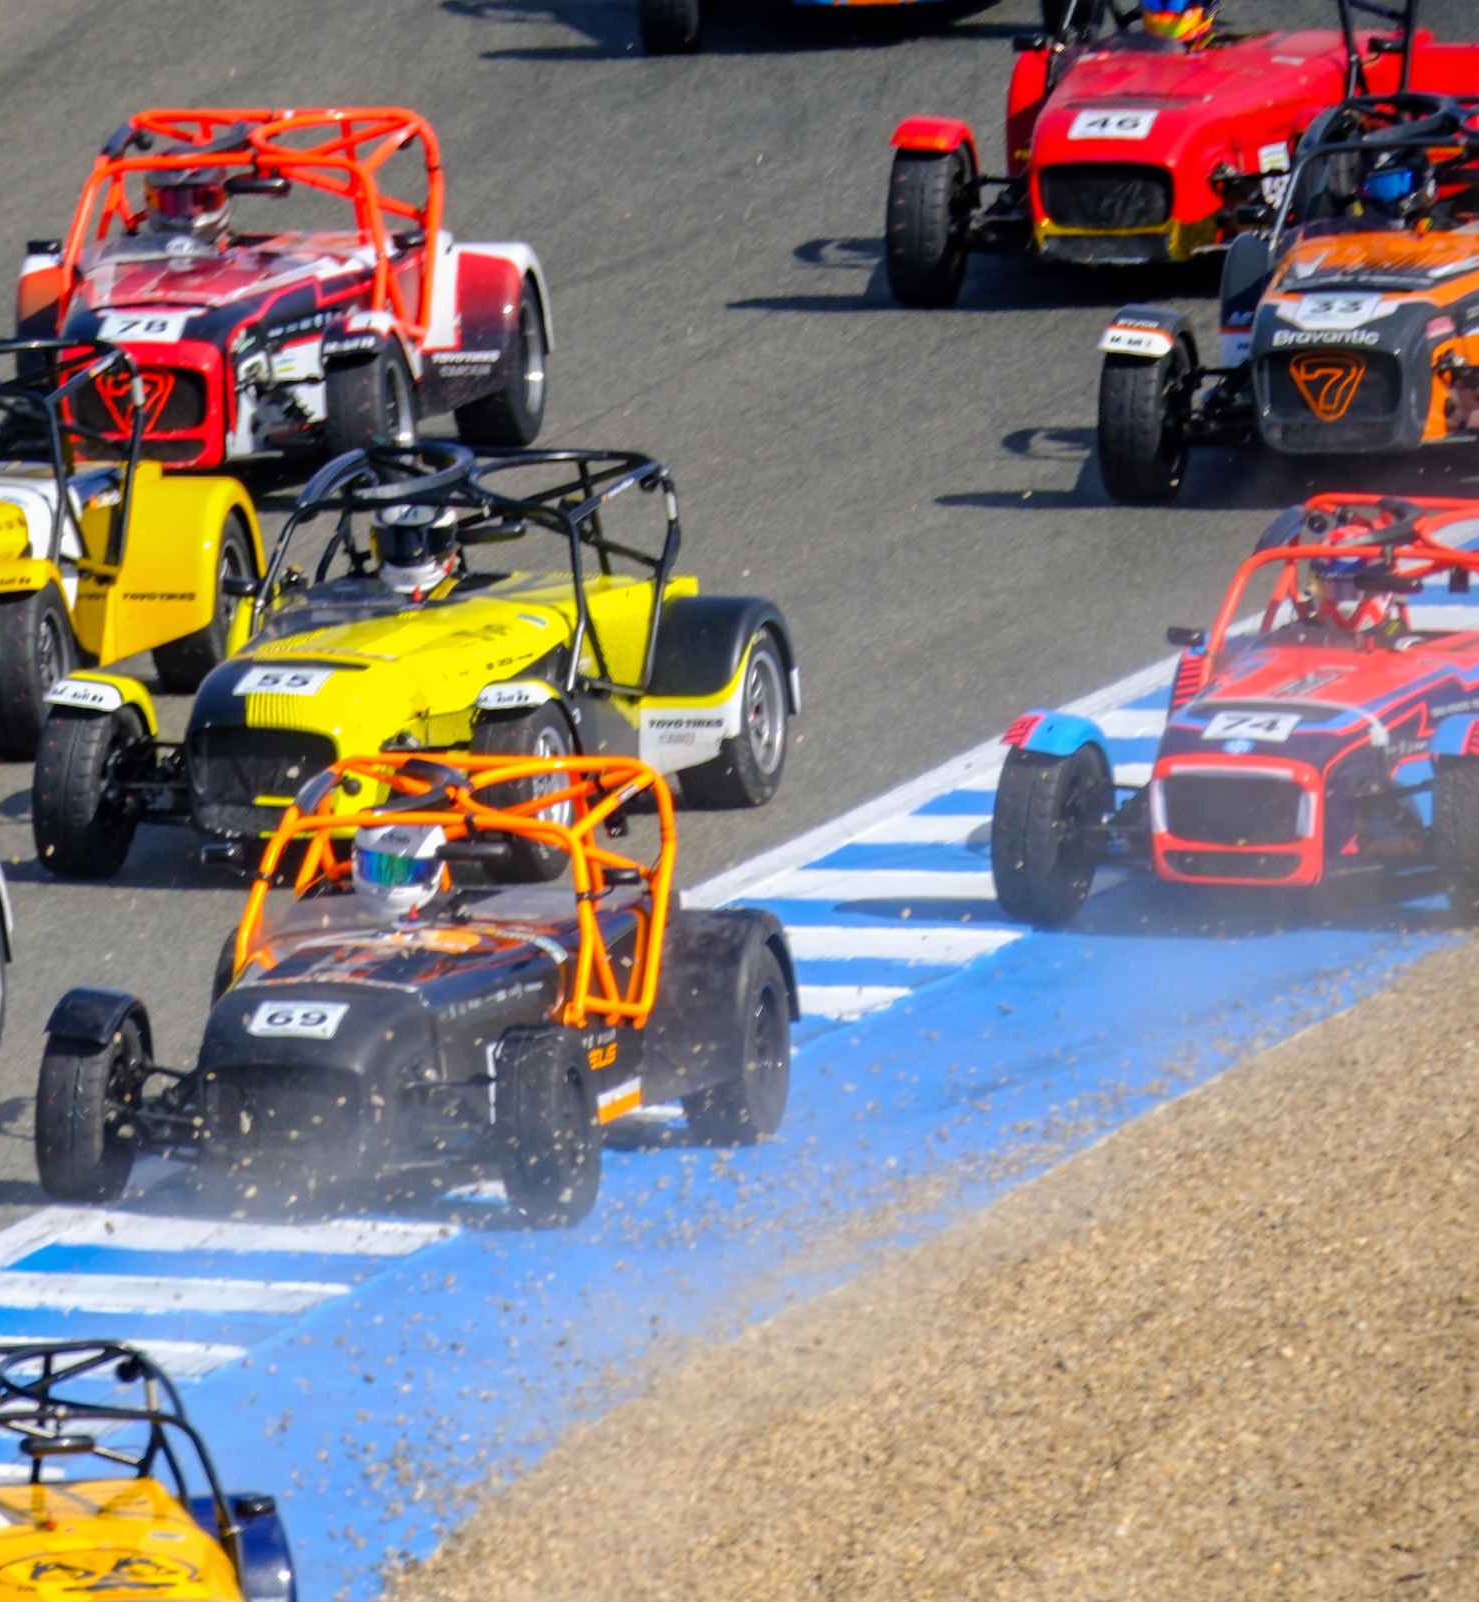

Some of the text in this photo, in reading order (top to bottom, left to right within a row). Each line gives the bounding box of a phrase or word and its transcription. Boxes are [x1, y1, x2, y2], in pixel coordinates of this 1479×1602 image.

[1085, 117, 1142, 131] 46
[1310, 300, 1362, 314] 33
[119, 319, 167, 334] 78
[257, 672, 311, 688] 55
[648, 717, 724, 729] TOYO TIRES
[1222, 716, 1282, 733] 74
[266, 1009, 329, 1028] 69
